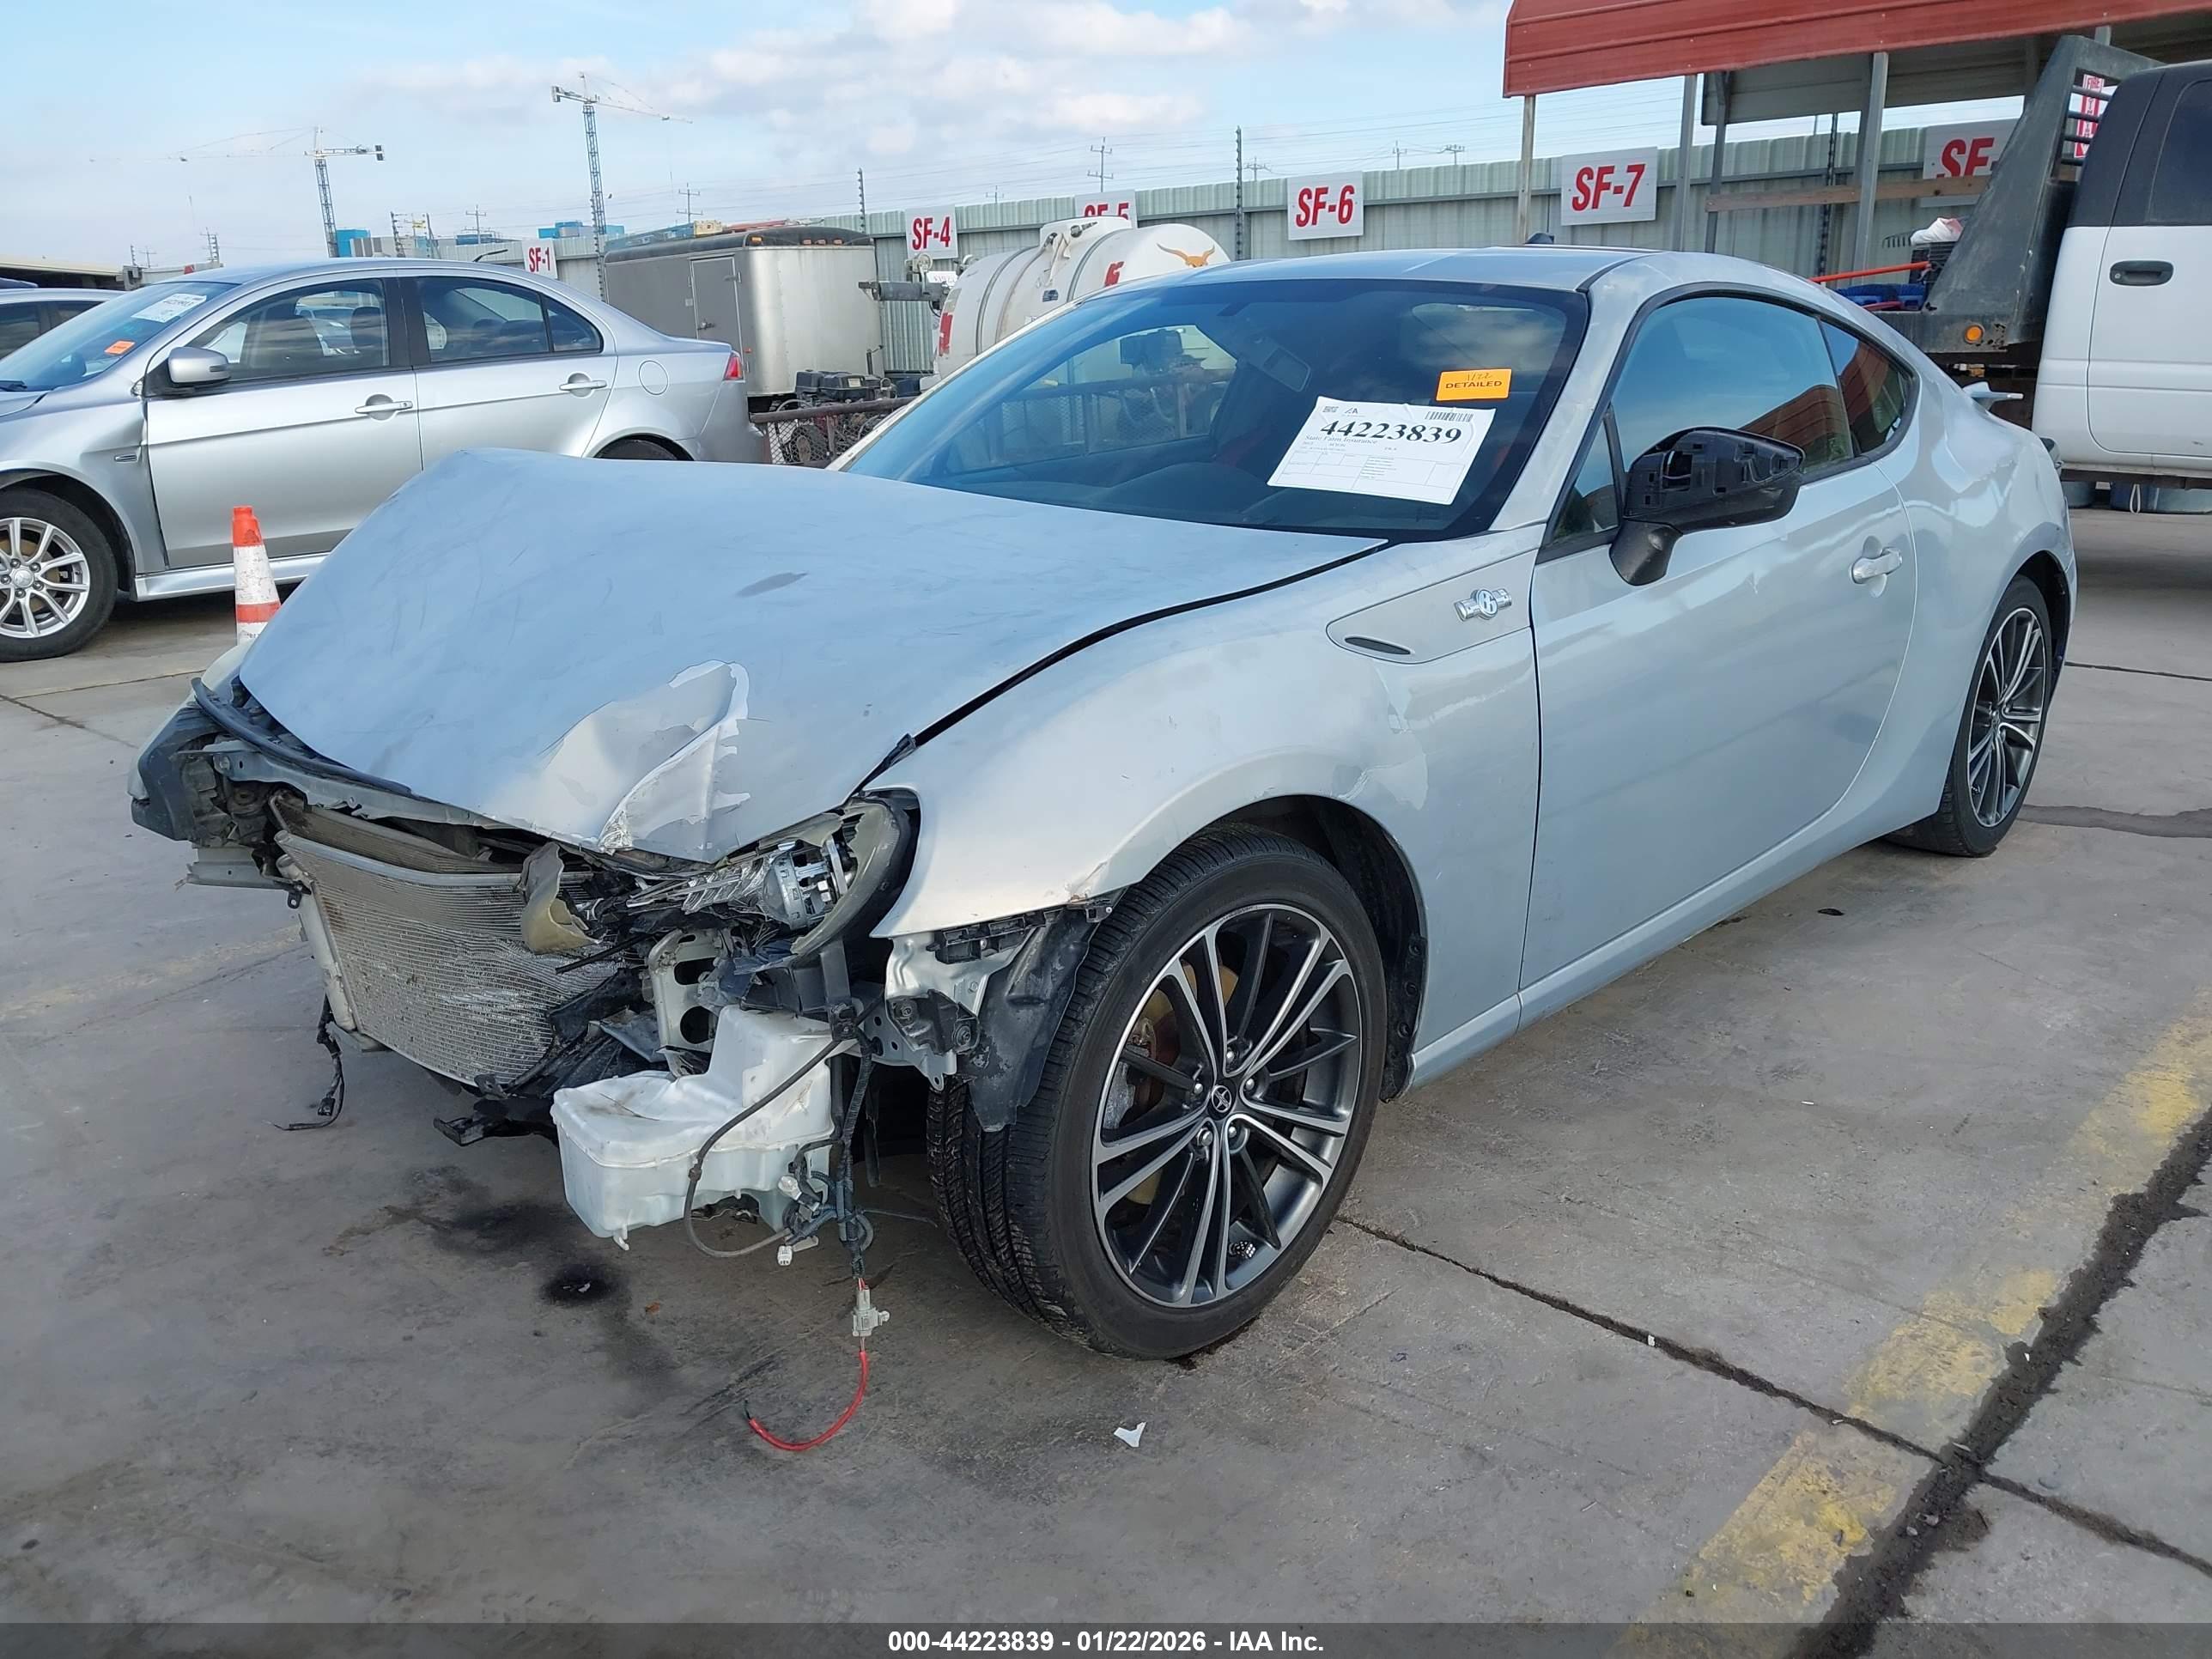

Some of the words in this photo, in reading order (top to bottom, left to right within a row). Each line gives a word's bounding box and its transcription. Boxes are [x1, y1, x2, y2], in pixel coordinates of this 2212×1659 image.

[1571, 163, 1646, 212] SF-7
[1296, 185, 1355, 228] SF-6
[912, 216, 951, 251] SF-4
[528, 246, 550, 272] SF-1
[1445, 380, 1503, 389] DETAILED
[1320, 420, 1462, 444] 44223839
